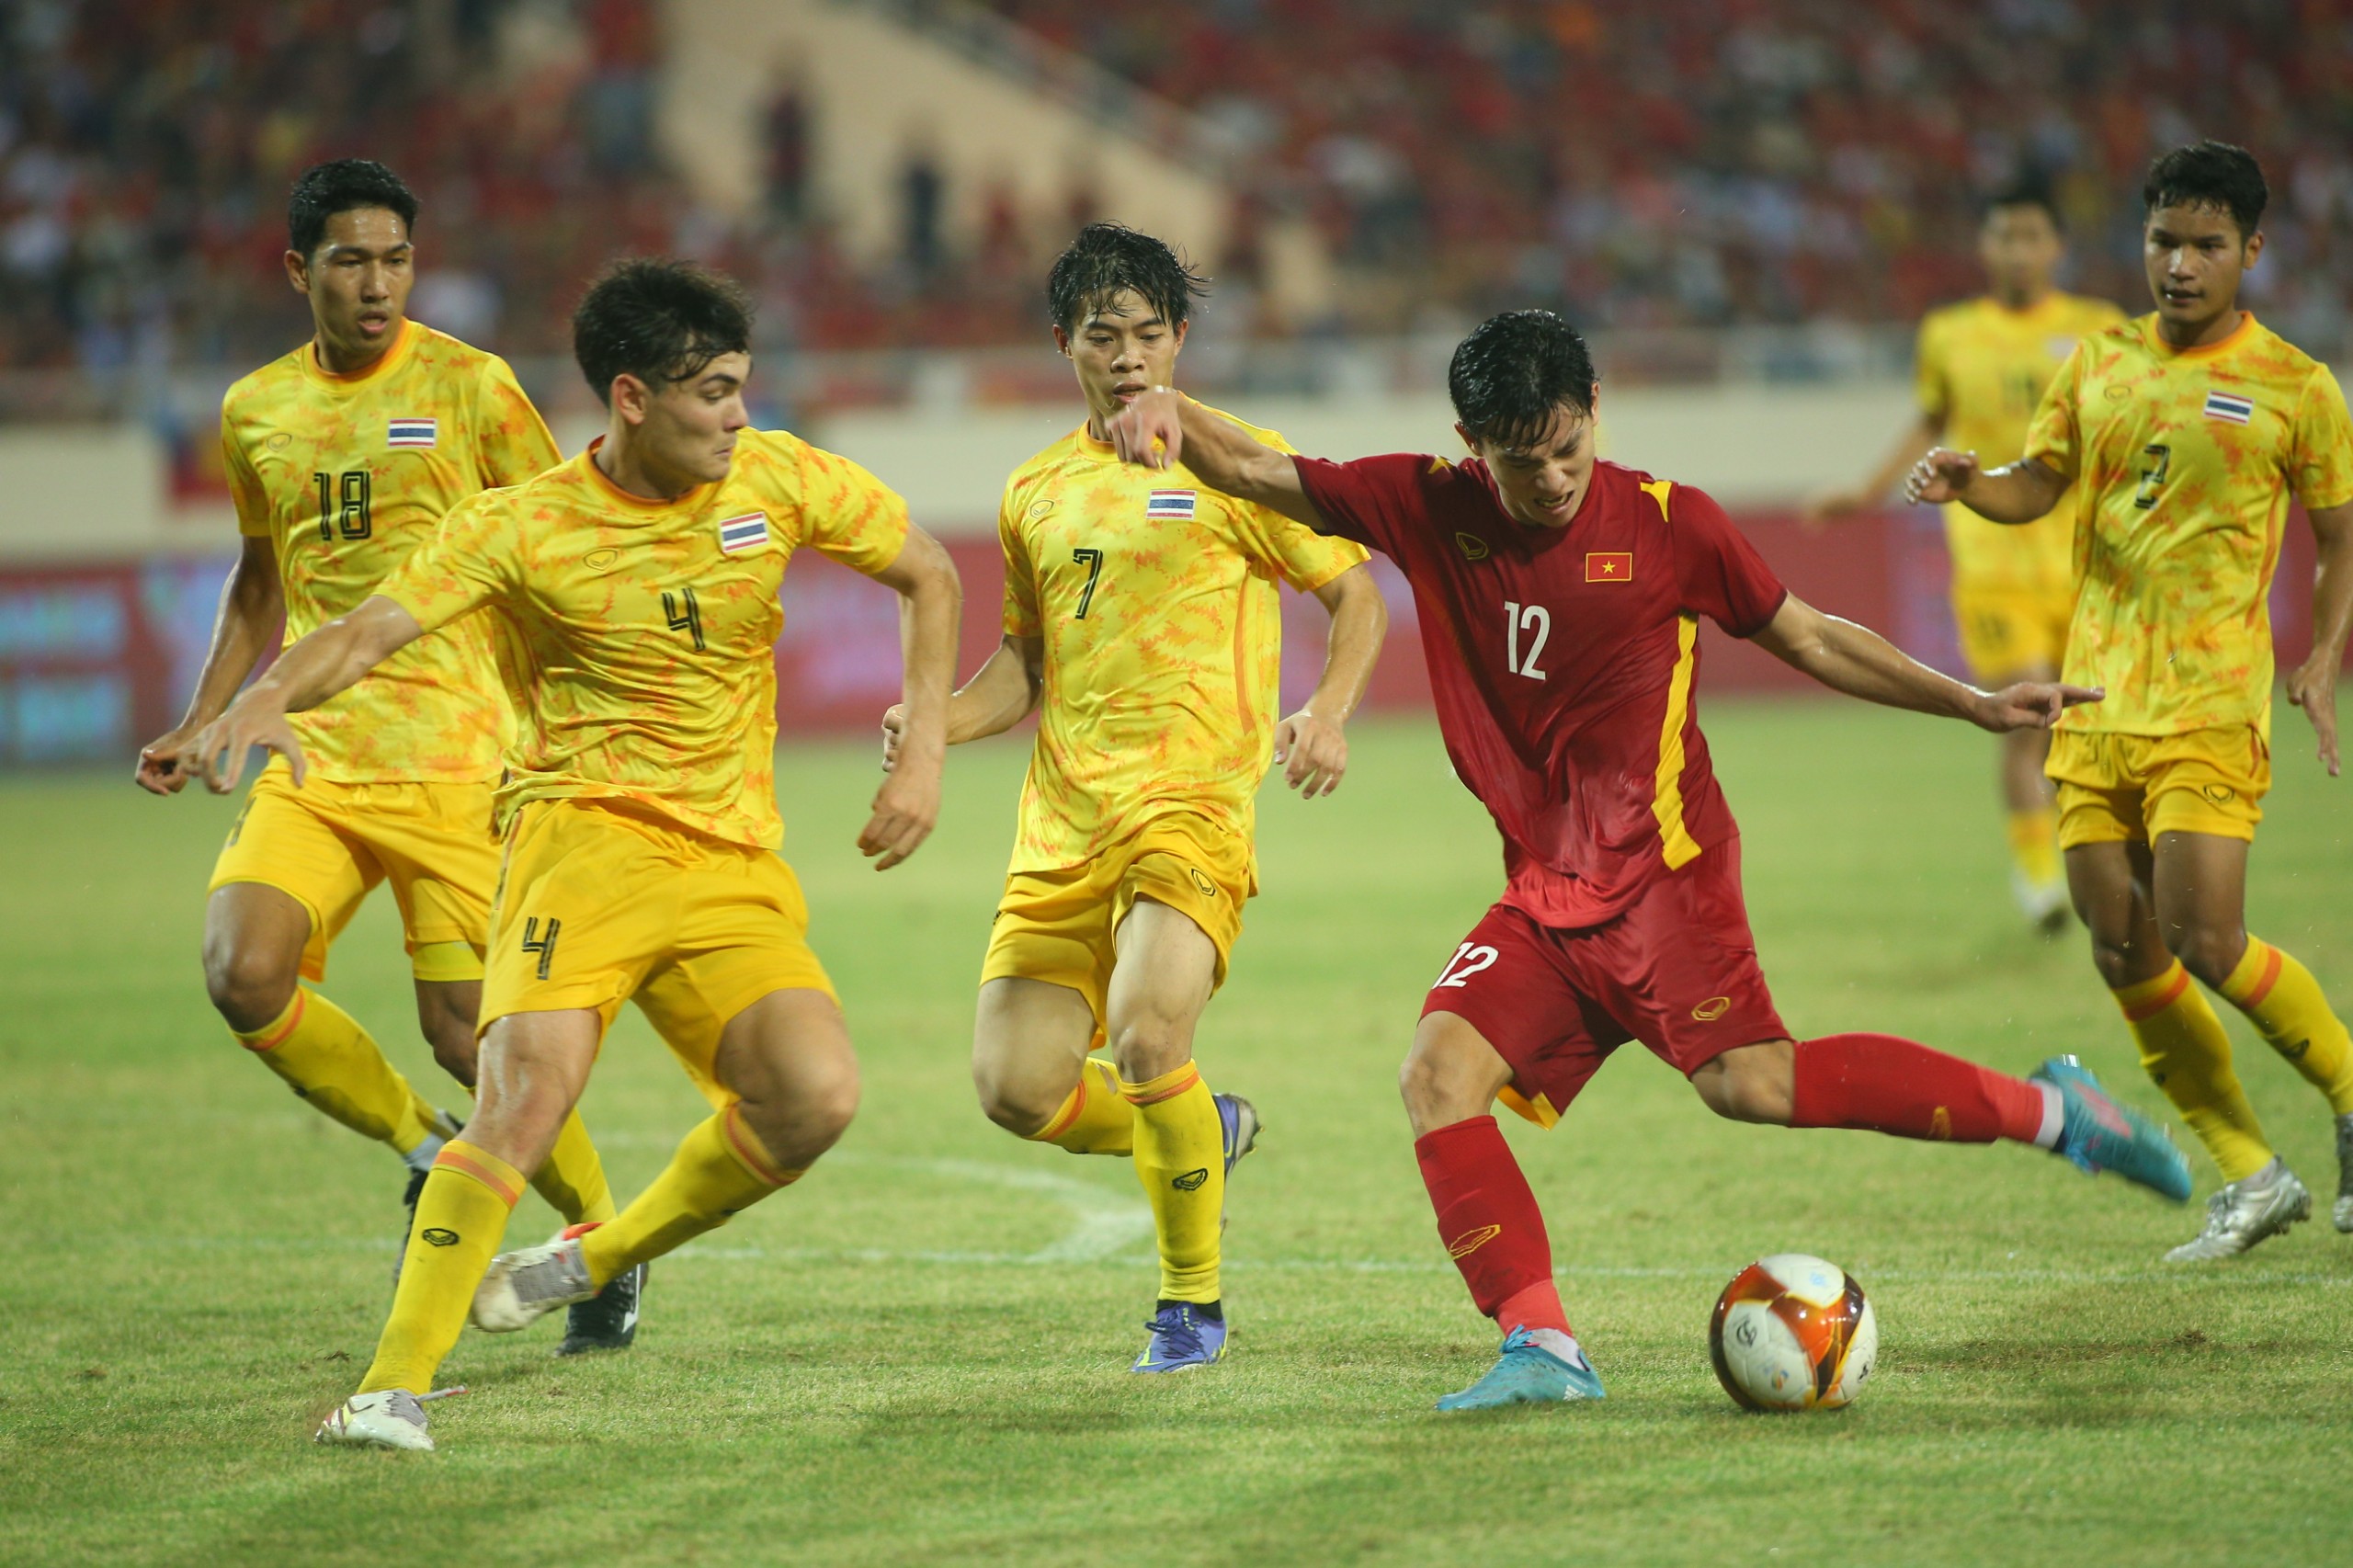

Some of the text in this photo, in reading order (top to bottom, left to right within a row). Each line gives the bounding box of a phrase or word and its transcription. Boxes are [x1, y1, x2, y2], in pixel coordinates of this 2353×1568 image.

[313, 472, 371, 540] 18
[2134, 445, 2170, 509] 2
[1073, 549, 1103, 619] 7
[662, 587, 706, 652] 4
[1505, 601, 1551, 680] 12
[521, 916, 561, 980] 4
[1431, 942, 1499, 990] 12
